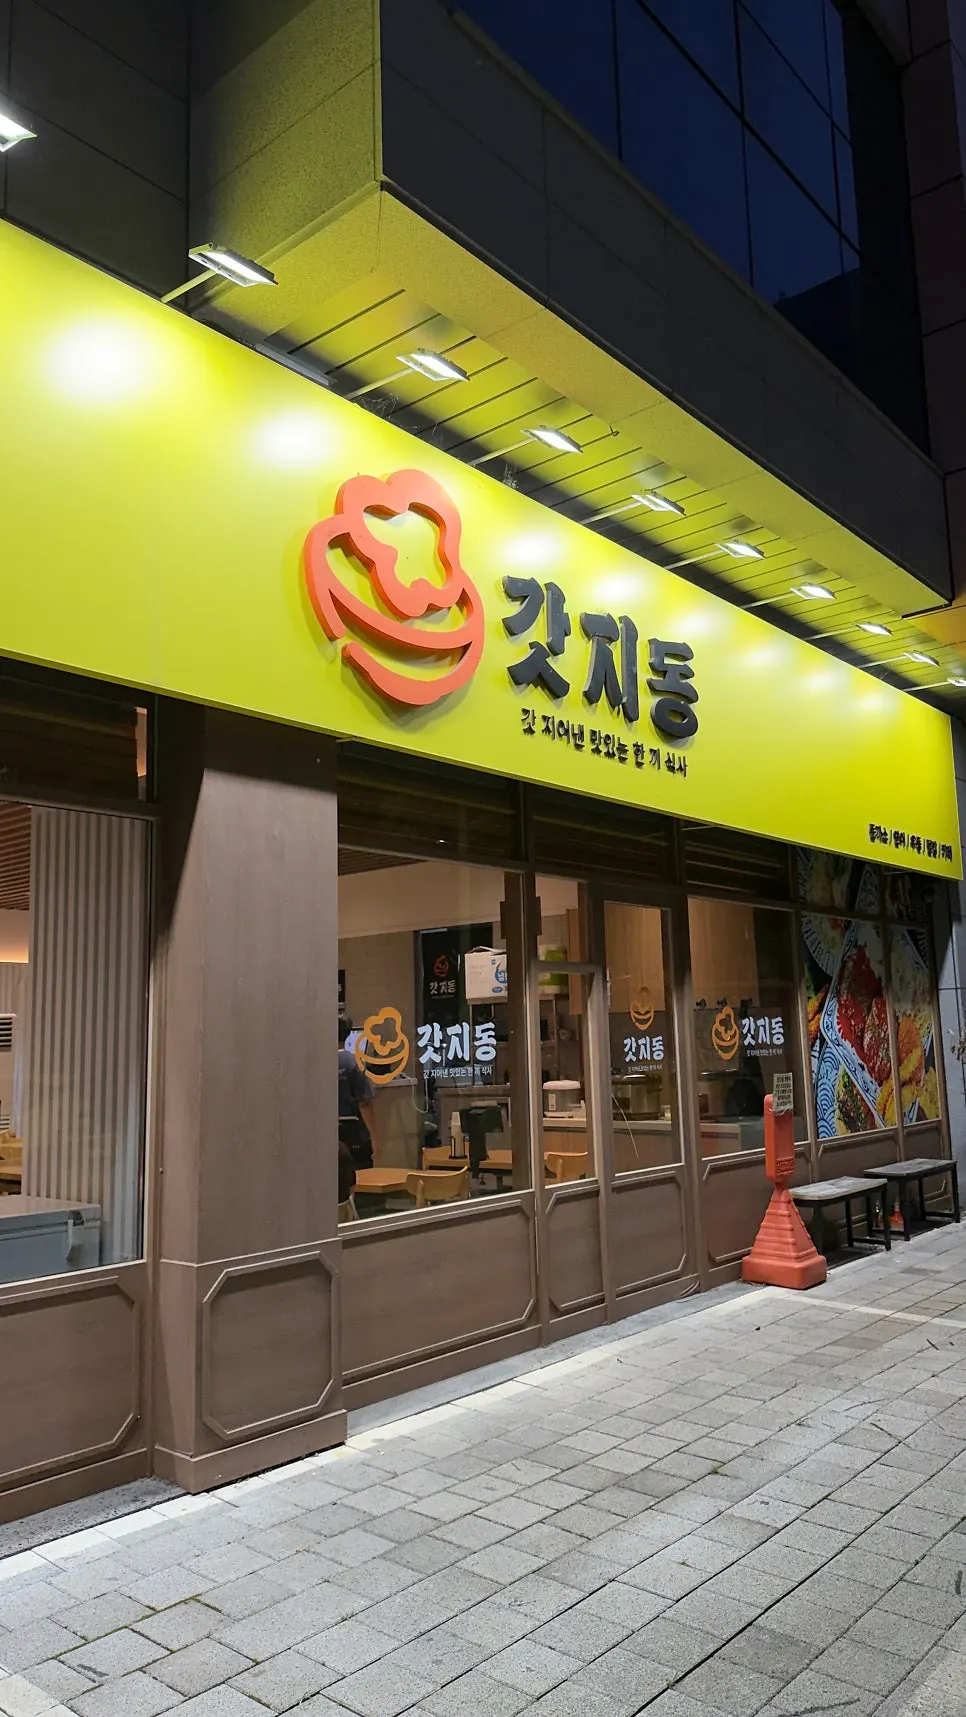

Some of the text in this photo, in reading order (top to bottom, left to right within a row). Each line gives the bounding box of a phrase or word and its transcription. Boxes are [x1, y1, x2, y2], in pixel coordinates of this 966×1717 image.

[501, 575, 699, 738] 갓지동
[521, 708, 688, 777] 갓 지어낸 맛있는 한 끼 식사
[430, 979, 457, 995] 갓지동
[417, 1022, 497, 1064] 갓지동
[741, 1016, 785, 1046] 갓지동
[623, 1035, 665, 1063] 갓지동
[423, 1070, 429, 1079] 갓
[431, 1067, 448, 1078] 지어낸
[449, 1067, 466, 1077] 맛있는
[481, 1065, 492, 1076] 식사
